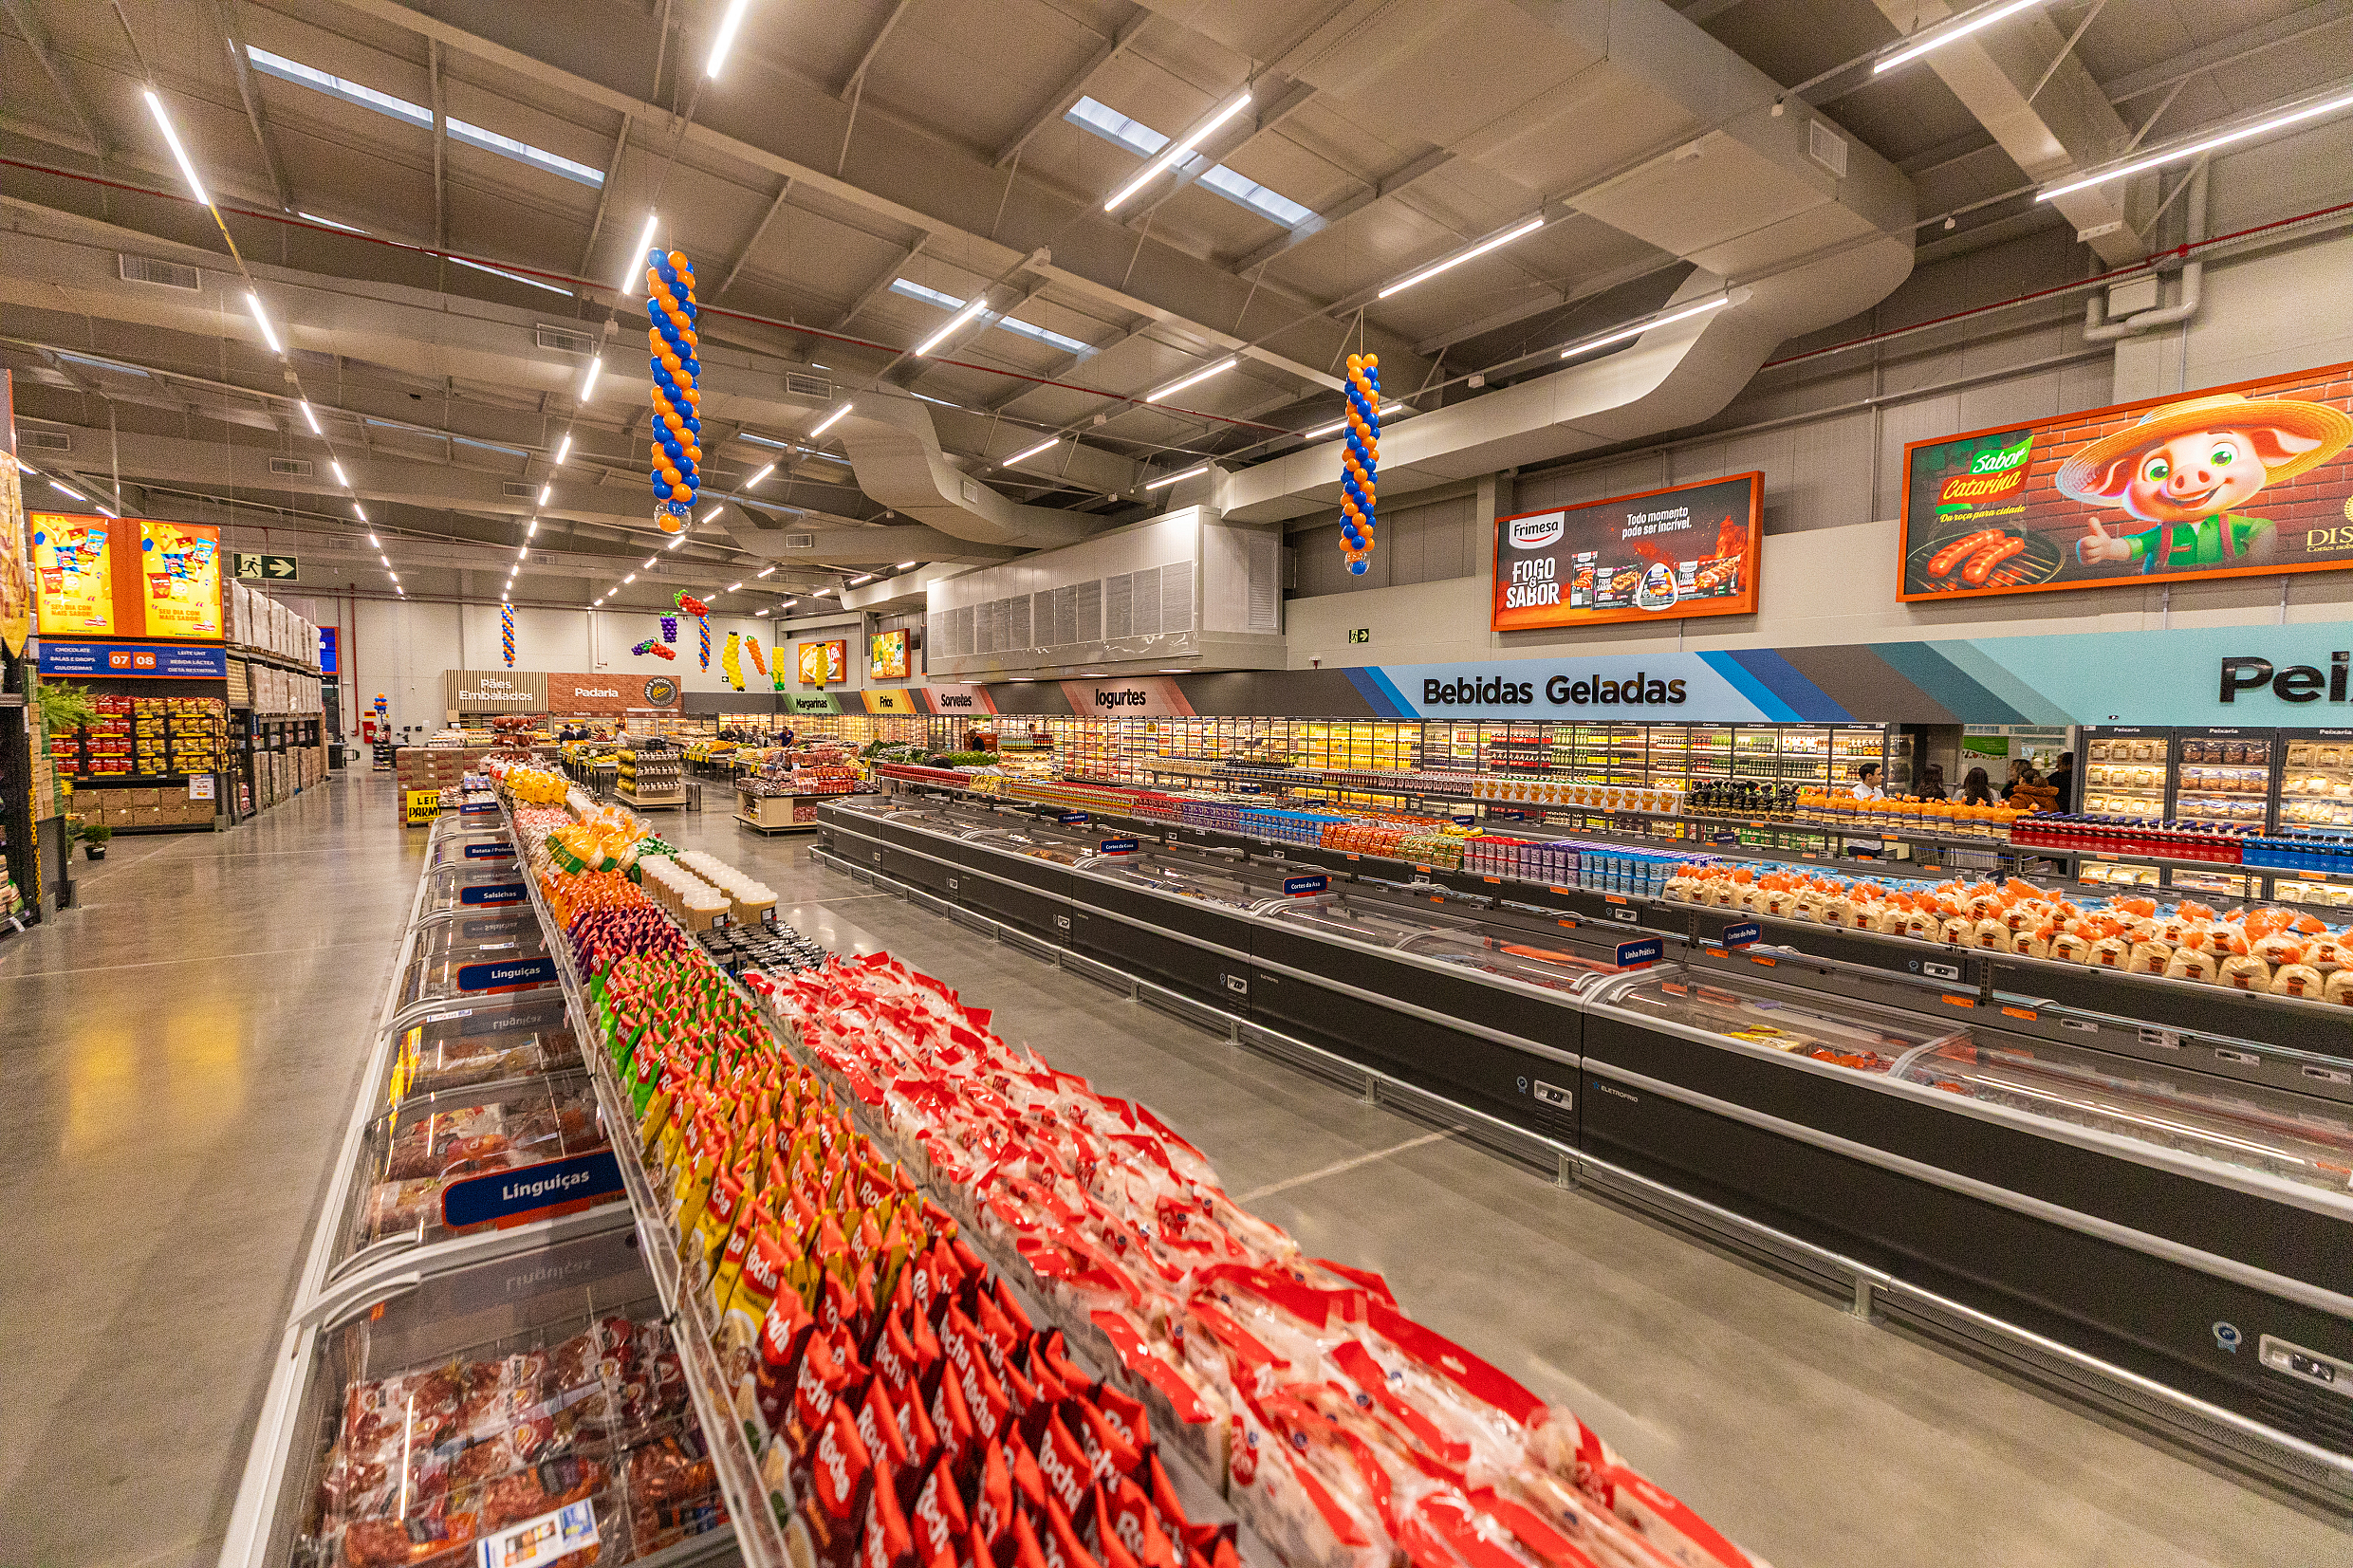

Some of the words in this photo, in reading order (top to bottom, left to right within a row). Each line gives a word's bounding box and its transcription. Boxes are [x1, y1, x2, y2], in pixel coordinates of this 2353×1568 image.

[1973, 448, 2027, 473] Sabor
[1943, 470, 2022, 500] Catarina
[1627, 512, 1646, 526] Todo
[1648, 507, 1688, 523] momento
[1940, 514, 1954, 523] Da
[1955, 512, 1973, 521] roça
[1972, 509, 1995, 521] para
[1995, 505, 2026, 515] cidade
[1514, 521, 1558, 537] Frimesa
[1622, 525, 1642, 541] pode
[1643, 524, 1658, 535] ser
[1658, 516, 1692, 533] incrível.
[2307, 544, 2334, 553] Cortes
[1512, 557, 1555, 582] FOGO
[1529, 577, 1537, 588] &
[1506, 582, 1561, 609] SABOR
[112, 655, 129, 665] 07
[136, 655, 155, 666] 08
[481, 678, 512, 690] Pães
[2219, 651, 2352, 703] Pei
[459, 691, 533, 702] Embalados
[575, 688, 619, 698] Padaria
[1423, 676, 1533, 705] Bebidas
[1546, 673, 1687, 705] Geladas
[796, 698, 827, 710] Margarinas
[880, 696, 893, 709] Frios
[940, 693, 973, 709] Sorvetes
[1095, 689, 1146, 710] Iogurtes
[1625, 950, 1638, 960] Linha
[1639, 948, 1655, 957] Prática
[491, 966, 541, 980] Linguiças
[503, 1170, 590, 1201] Linguiças
